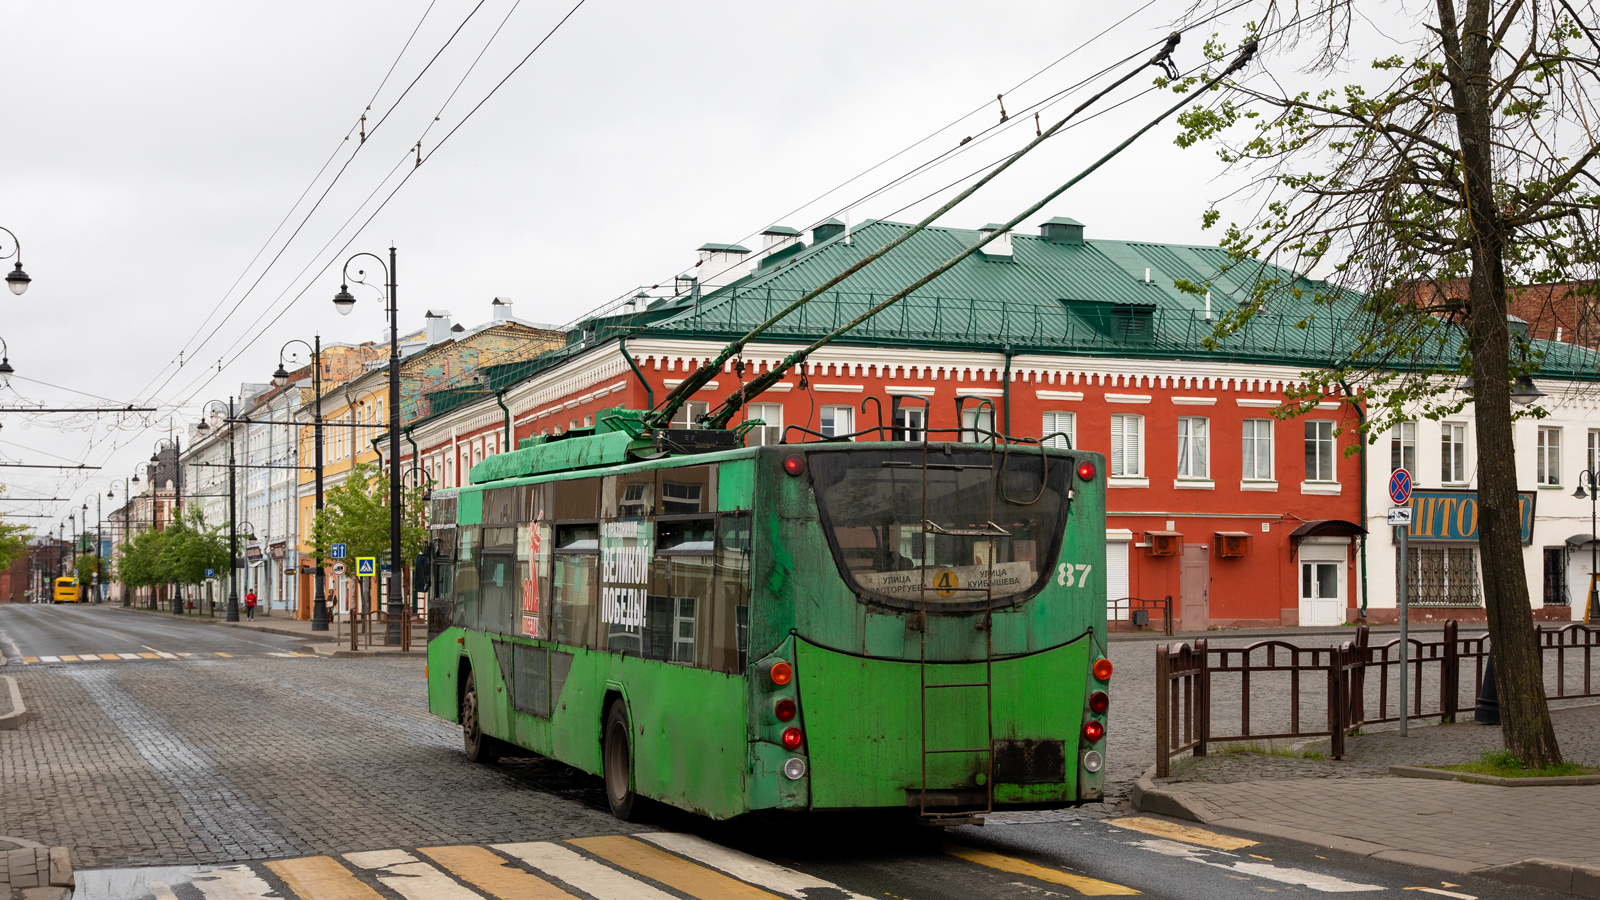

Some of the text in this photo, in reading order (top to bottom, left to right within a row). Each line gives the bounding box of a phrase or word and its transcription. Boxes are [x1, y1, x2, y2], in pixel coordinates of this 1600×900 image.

[1407, 497, 1527, 539] ШТО
[603, 539, 649, 585] ВЕЛИКОЙ
[980, 569, 1008, 578] УЛИЦА
[1057, 562, 1092, 588] 87
[883, 575, 911, 585] УЛИЦА
[938, 572, 952, 594] 4
[968, 577, 1020, 588] КУЙБЫШЕВА
[523, 577, 533, 611] 80
[602, 587, 647, 633] ПОБЕДЫ!
